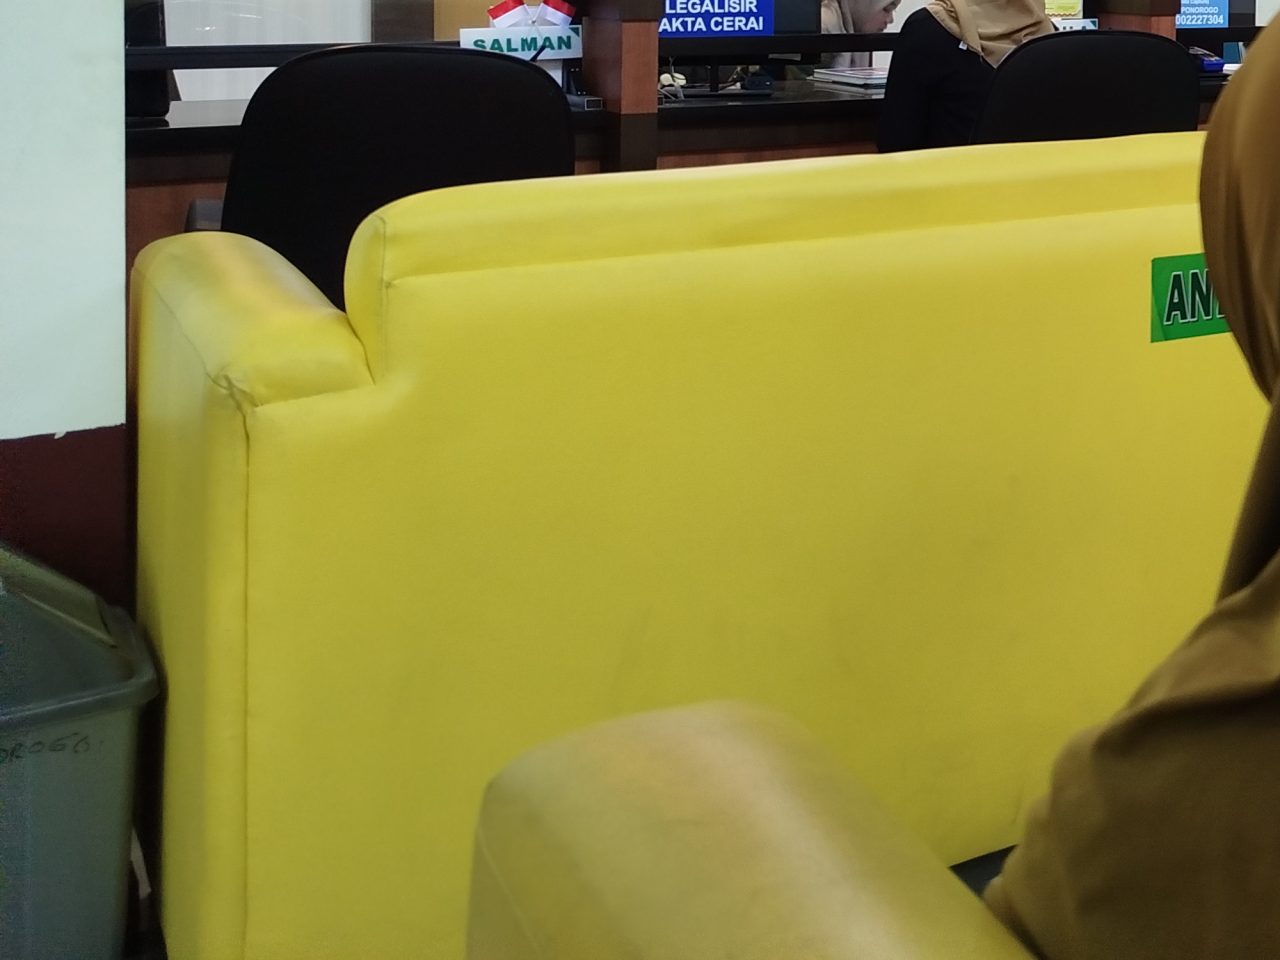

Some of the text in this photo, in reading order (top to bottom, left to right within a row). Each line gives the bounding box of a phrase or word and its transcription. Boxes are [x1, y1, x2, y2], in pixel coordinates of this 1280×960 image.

[1181, 6, 1219, 14] PONOROGO
[658, 16, 764, 33] AKTA CERAI
[473, 35, 572, 53] SALMAN
